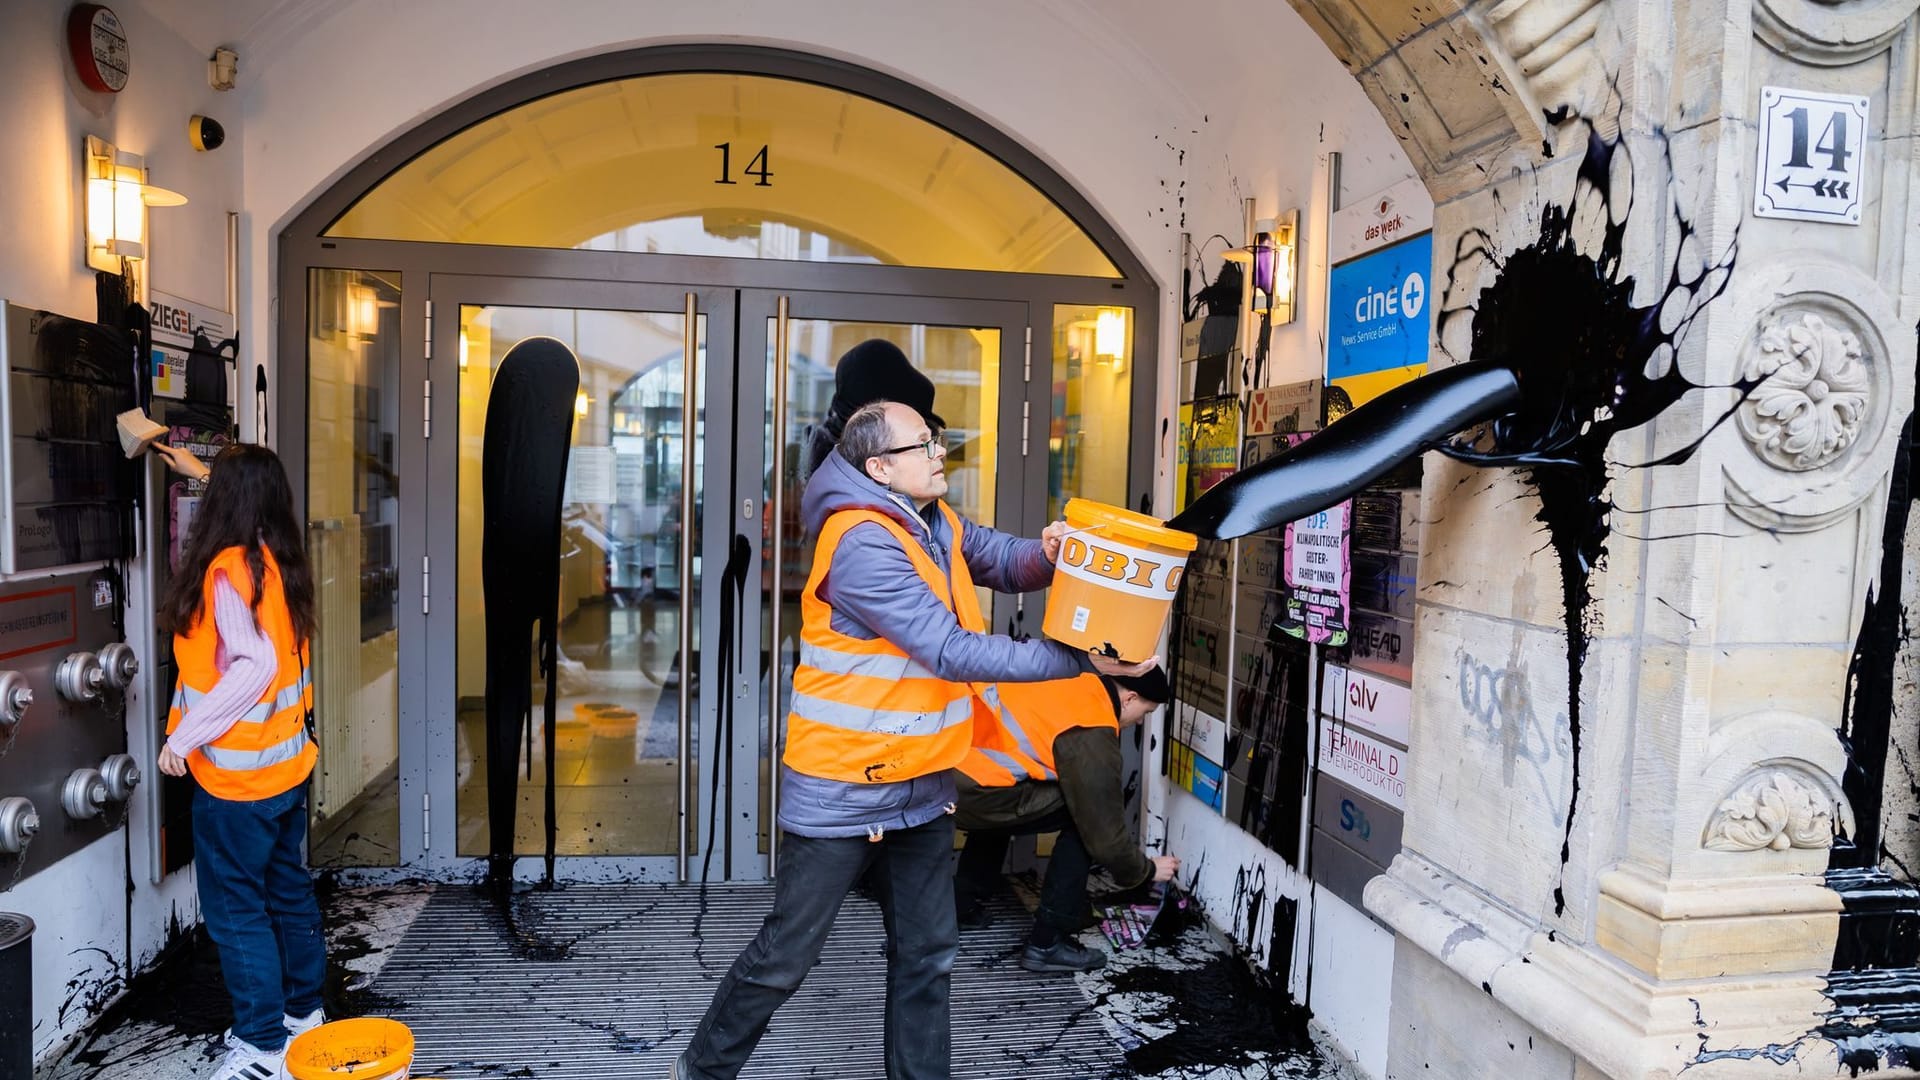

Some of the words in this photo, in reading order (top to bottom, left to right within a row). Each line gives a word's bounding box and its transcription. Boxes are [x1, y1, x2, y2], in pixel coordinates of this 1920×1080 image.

[1782, 107, 1852, 173] 14
[714, 142, 774, 187] 14
[1365, 226, 1380, 241] das
[1381, 214, 1402, 236] werk
[151, 302, 195, 335] ZIEGEL
[1355, 286, 1398, 324] cine
[1341, 334, 1357, 346] News
[1357, 327, 1378, 342] Service
[1378, 323, 1397, 337] GmbH
[1062, 536, 1161, 589] OBI
[1349, 678, 1378, 713] alv
[1326, 727, 1385, 772] TERMINAL
[1388, 754, 1399, 777] D
[1321, 748, 1406, 799] EDIENPRODUKTIO
